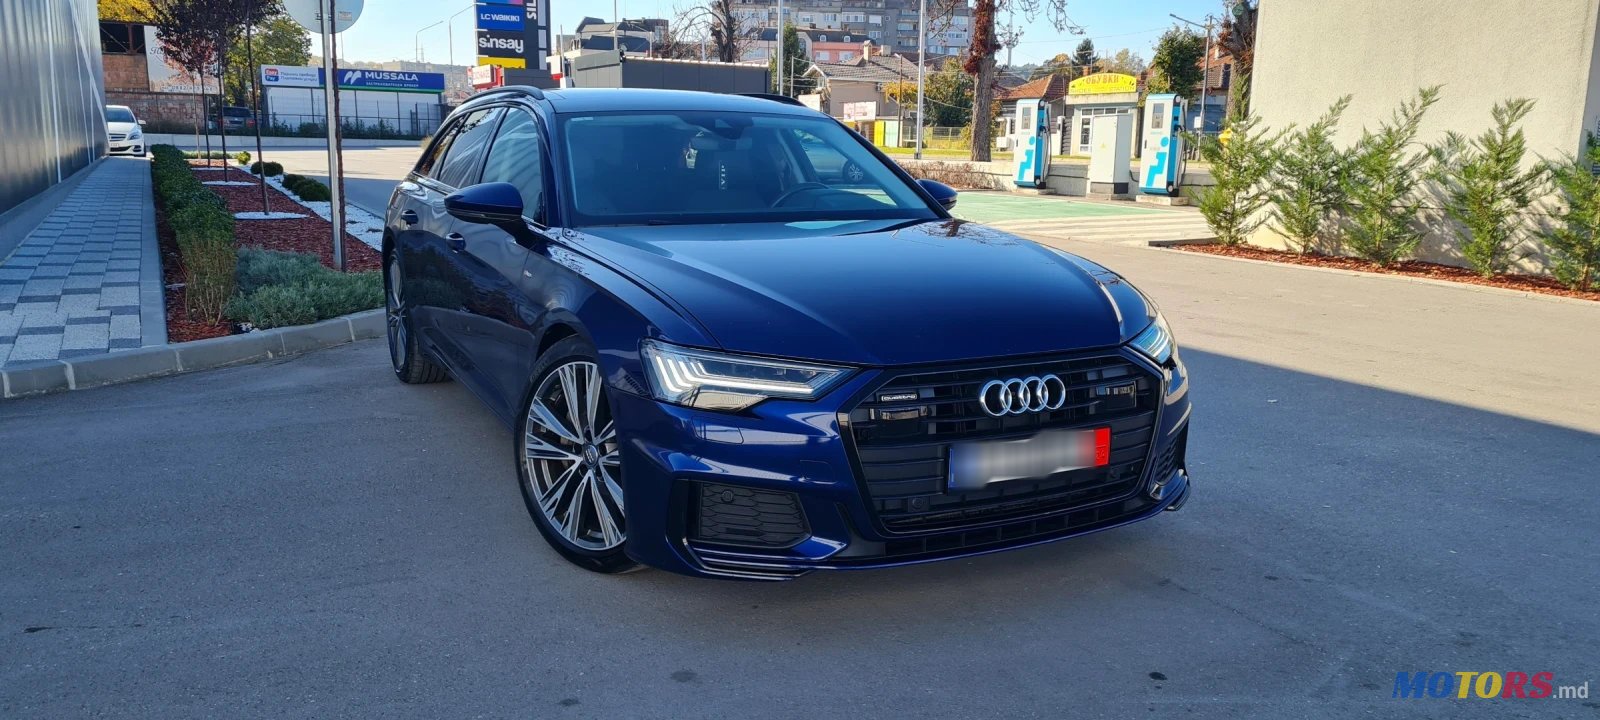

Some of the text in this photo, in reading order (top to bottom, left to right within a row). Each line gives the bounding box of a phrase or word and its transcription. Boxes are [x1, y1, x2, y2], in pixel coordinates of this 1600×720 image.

[479, 34, 524, 53] sinsay
[365, 71, 419, 81] MUSSALA
[1086, 74, 1119, 84] ОБУВКИ
